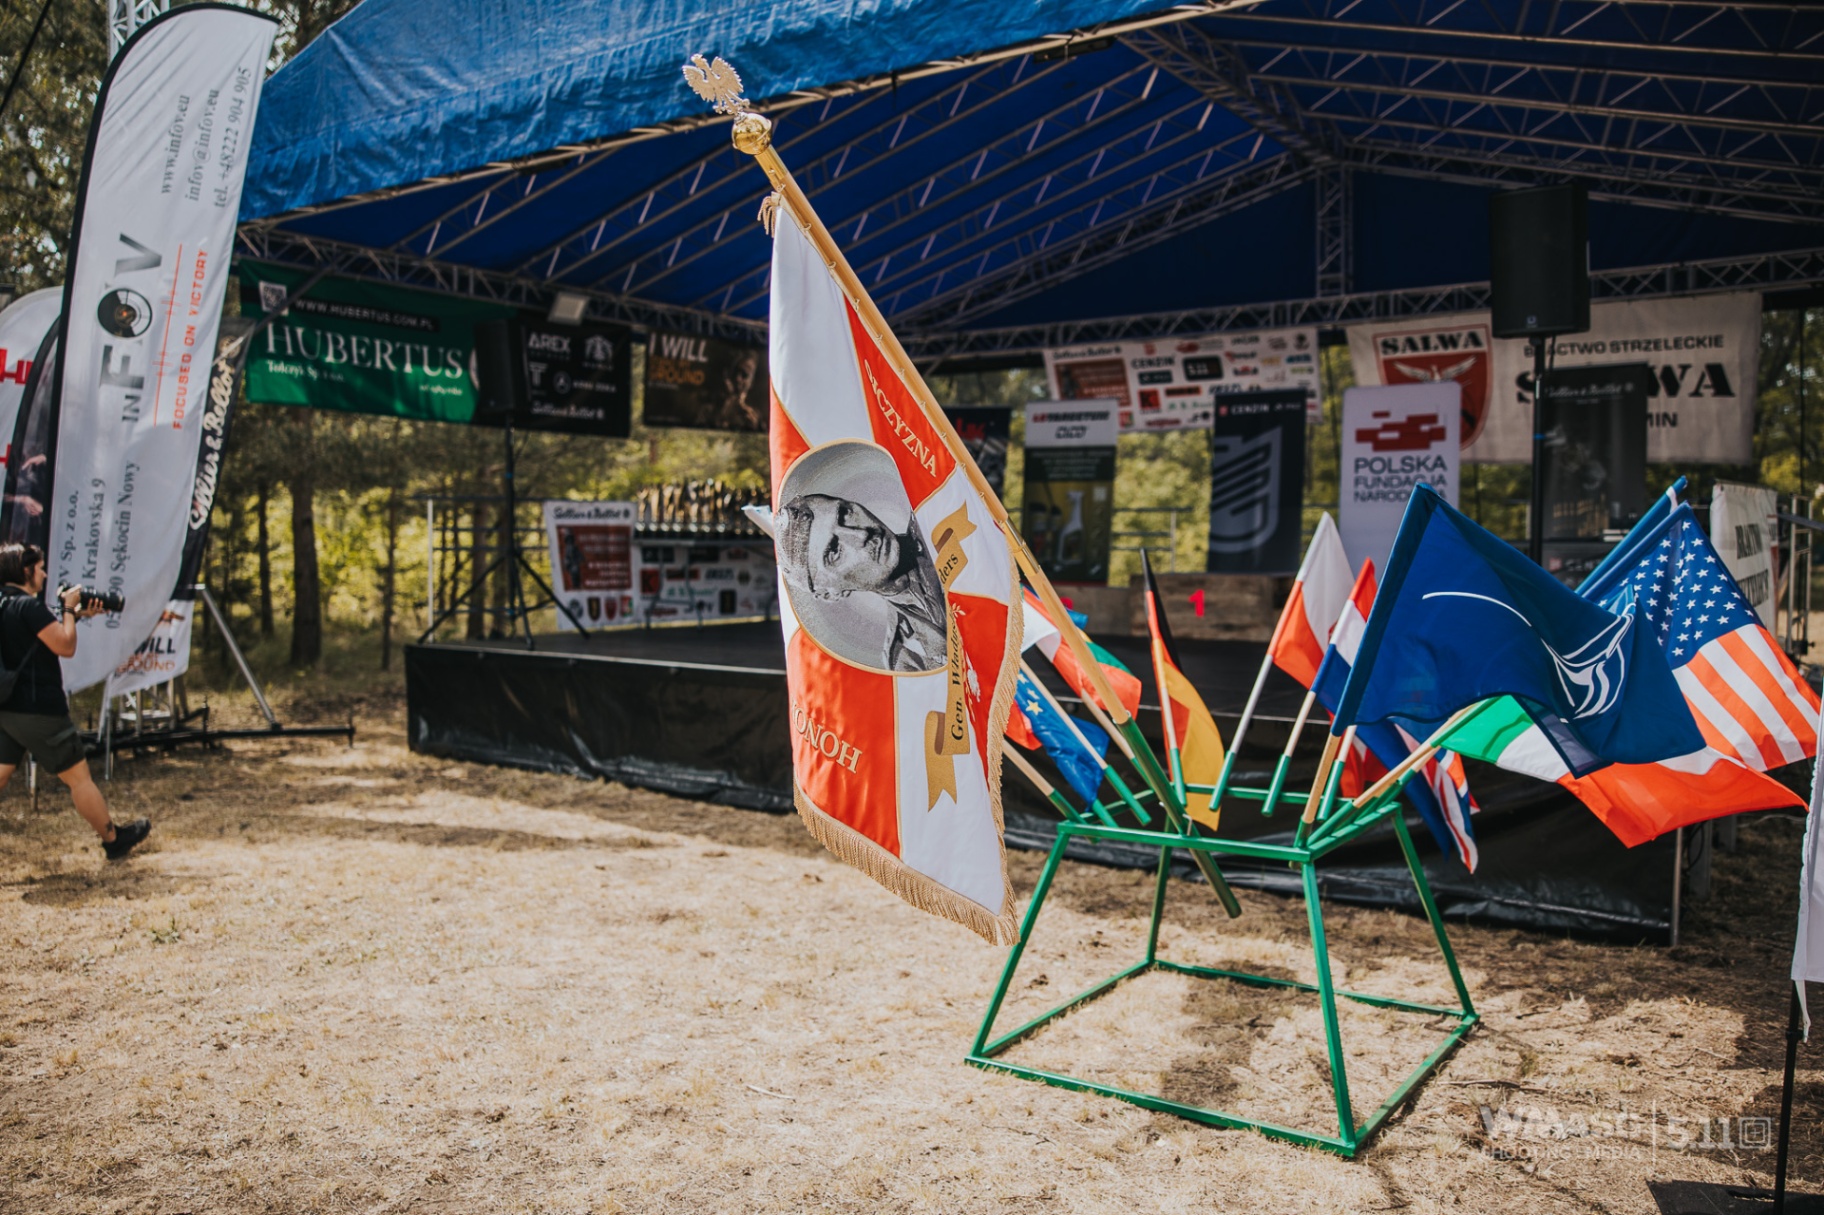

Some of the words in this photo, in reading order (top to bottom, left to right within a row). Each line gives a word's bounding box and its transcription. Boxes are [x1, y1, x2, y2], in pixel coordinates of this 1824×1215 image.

[234, 67, 251, 95] 905
[227, 97, 245, 124] 904
[161, 94, 190, 194] www.infov.eu
[185, 88, 220, 202] infov@infov.eu
[213, 186, 228, 208] tel.
[188, 248, 208, 317] VICTORY
[296, 300, 435, 330] WWW.HUBERTUS.COM.PL
[184, 324, 196, 348] ON
[266, 322, 464, 379] HUBERTUS
[528, 332, 572, 352] AREX
[661, 334, 709, 363] WILL
[1380, 331, 1484, 355] SALWA
[1524, 341, 1606, 357] BACTWO
[1609, 335, 1724, 354] STRZELECKIE
[172, 353, 193, 431] FOCUSED
[1516, 363, 1736, 404] SWA
[1354, 455, 1447, 474] POLSKA
[91, 478, 105, 488] 9
[117, 461, 140, 504] Nowy
[188, 451, 220, 530] Sellier
[205, 434, 223, 450] &
[1354, 474, 1447, 490] FUNDACJA
[1354, 488, 1447, 503] NARODA
[66, 523, 75, 532] z
[82, 493, 105, 579] Krakowska
[110, 511, 131, 572] Sękocin
[939, 553, 959, 585] ders
[1188, 589, 1205, 617] 1
[951, 697, 964, 740] Gen.
[791, 700, 863, 775] HONO
